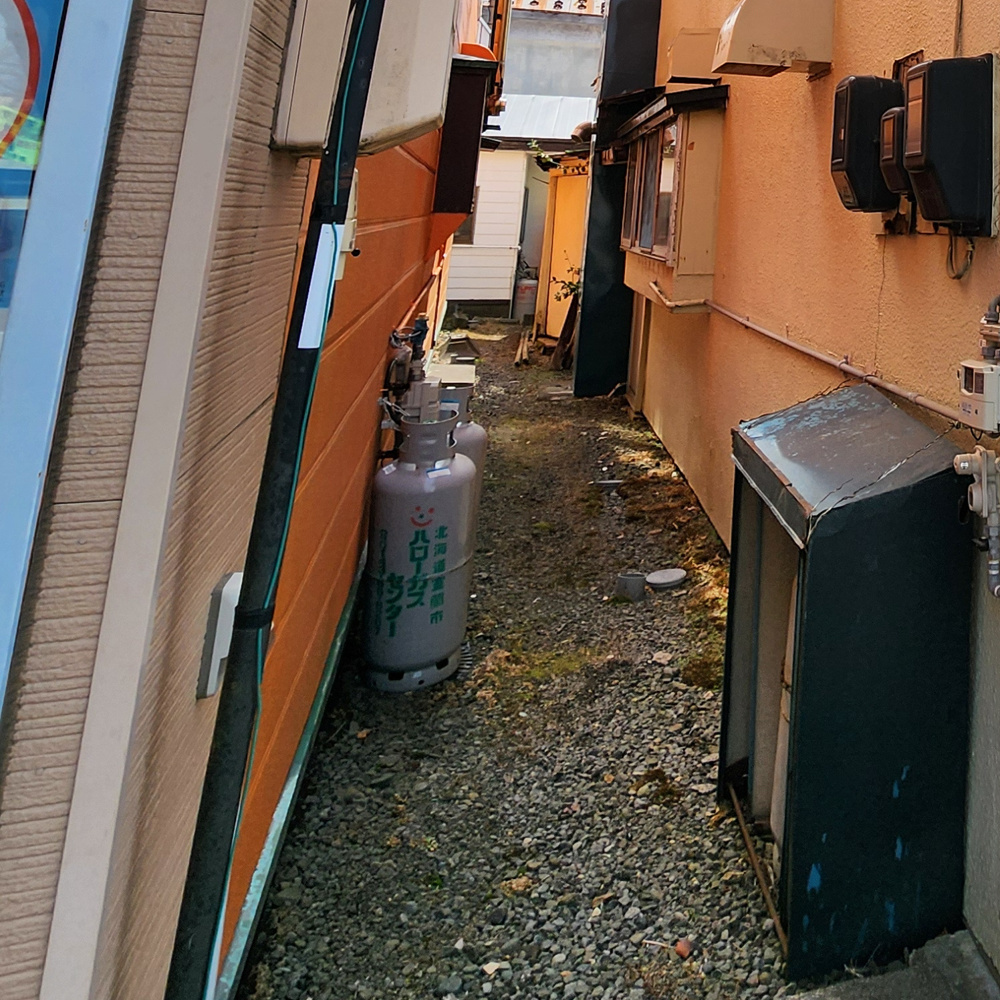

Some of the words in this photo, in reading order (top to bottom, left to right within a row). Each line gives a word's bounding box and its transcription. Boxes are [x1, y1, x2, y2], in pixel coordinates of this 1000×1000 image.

[386, 572, 404, 638] センター
[406, 529, 430, 609] ハローガス
